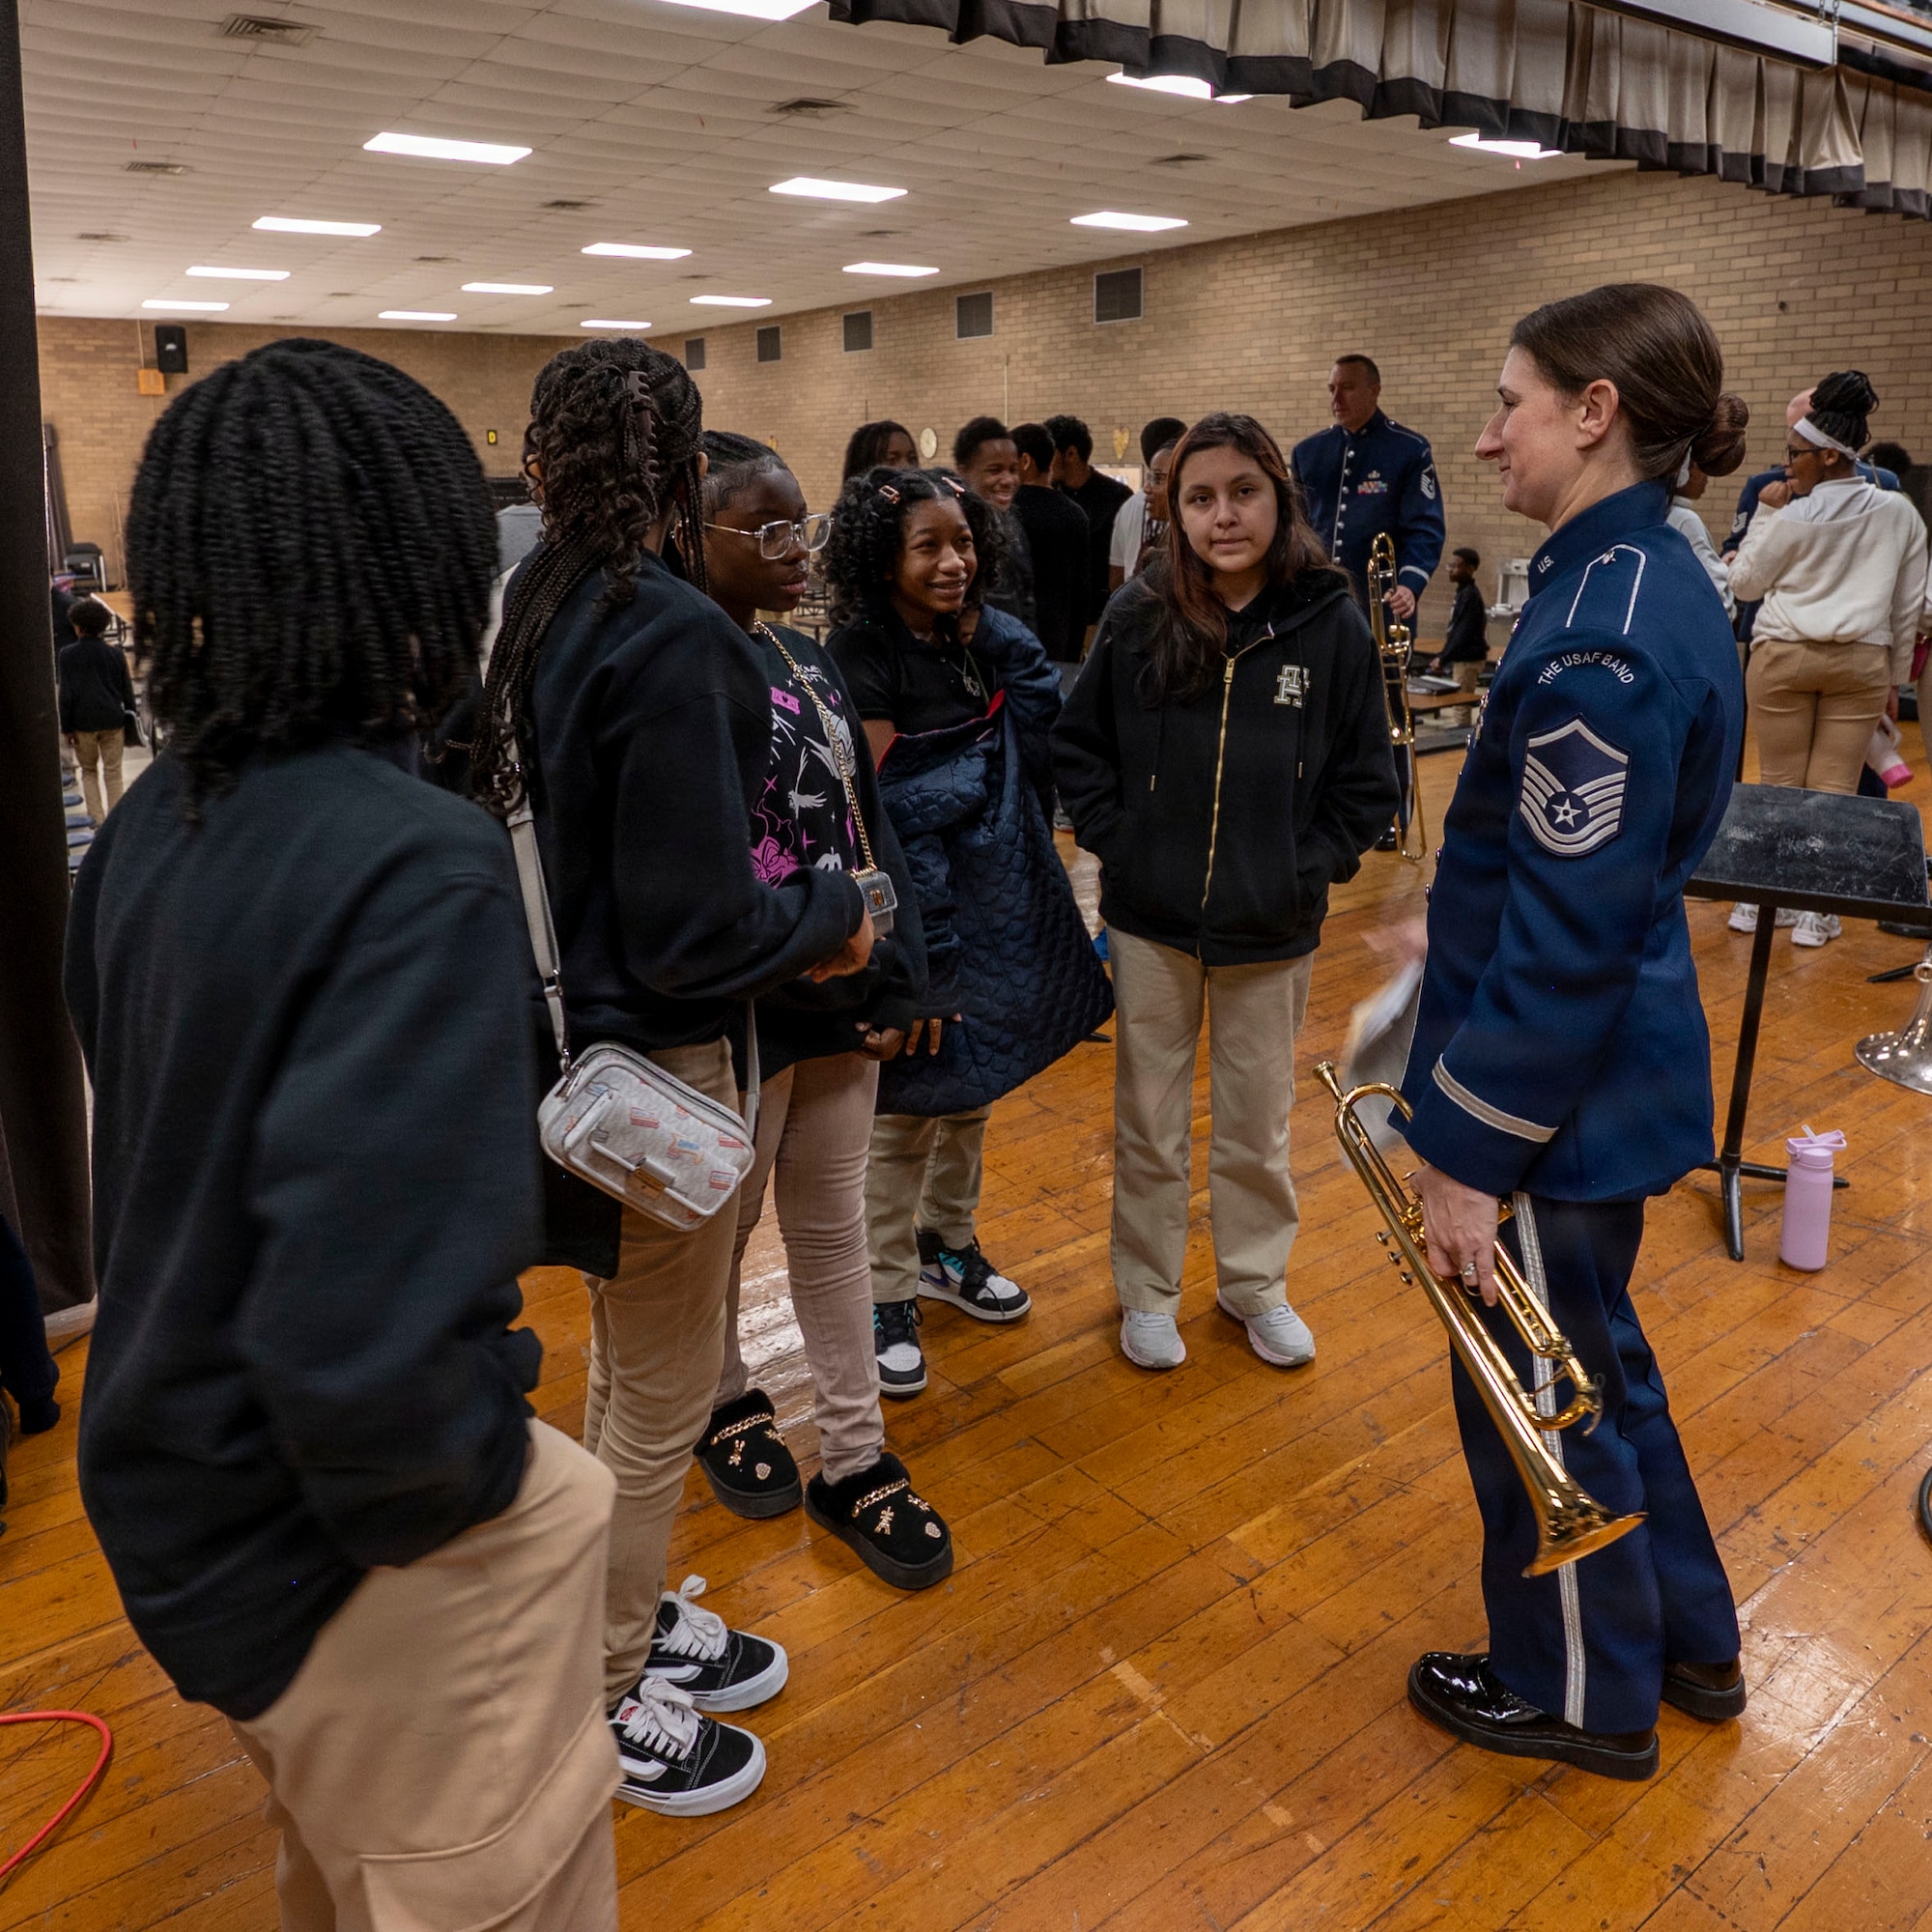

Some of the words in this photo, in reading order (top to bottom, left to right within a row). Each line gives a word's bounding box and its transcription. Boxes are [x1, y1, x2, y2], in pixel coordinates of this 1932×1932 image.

[1538, 661, 1563, 685] THE
[1561, 652, 1603, 667] USAF
[1601, 654, 1634, 684] BAND
